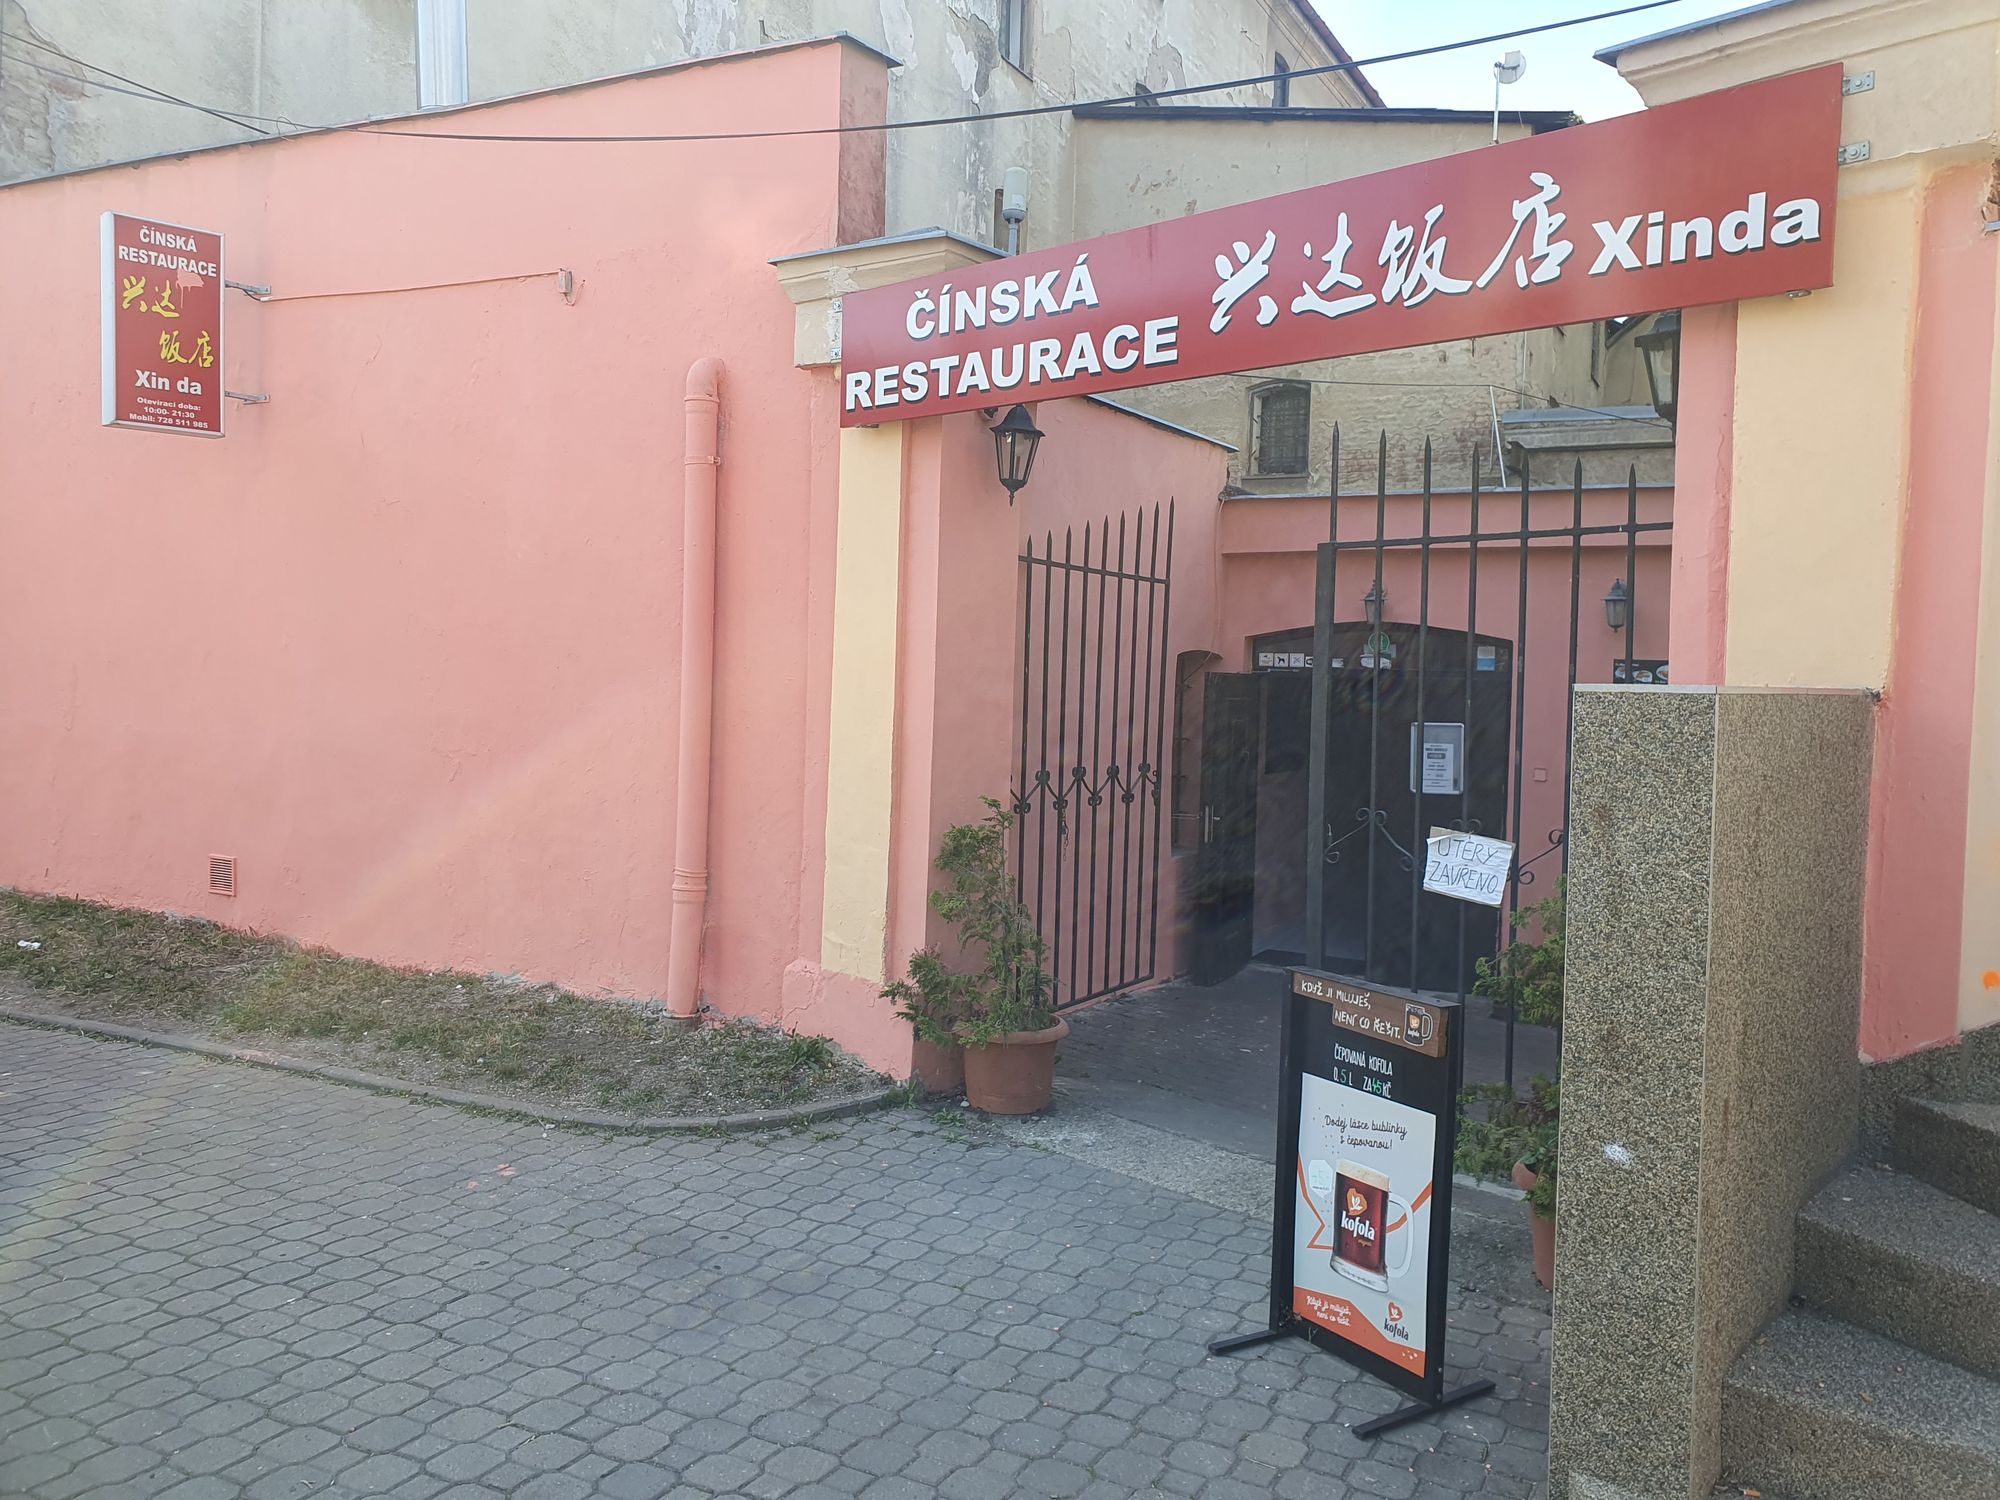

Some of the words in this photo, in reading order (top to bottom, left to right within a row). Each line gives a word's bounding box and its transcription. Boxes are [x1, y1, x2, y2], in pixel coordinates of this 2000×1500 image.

[140, 225, 197, 253] ČÍNSKÁ
[1208, 172, 1576, 334] 兴达饭店
[1588, 192, 1820, 276] Xinda
[119, 245, 216, 277] RESTAURACE
[122, 275, 180, 318] 兴达
[907, 253, 1098, 340] ČÍNSKÁ
[159, 330, 214, 368] 饭店
[845, 316, 1179, 410] RESTAURACE
[135, 369, 170, 391] Xin
[176, 376, 202, 396] da
[129, 412, 156, 422] Mobil:
[157, 416, 173, 425] 728
[175, 418, 190, 427] 511
[193, 421, 208, 429] 985
[144, 406, 170, 415] 10:00-
[172, 410, 195, 419] 21:30
[178, 402, 201, 411] doba:
[1301, 980, 1323, 996] KDYŽ
[1326, 987, 1333, 999] JI
[1334, 1009, 1357, 1027] NENÍ
[1359, 1016, 1370, 1030] CO
[1373, 1016, 1401, 1039] ŘEŠIT.
[1334, 1042, 1366, 1068] ČEPOVANÁ
[1368, 1055, 1393, 1076] KOFOLA
[1324, 1114, 1347, 1133] Dodej
[1371, 1119, 1408, 1140] bublinky
[1341, 1210, 1376, 1241] kofola
[1384, 1318, 1409, 1341] kofola
